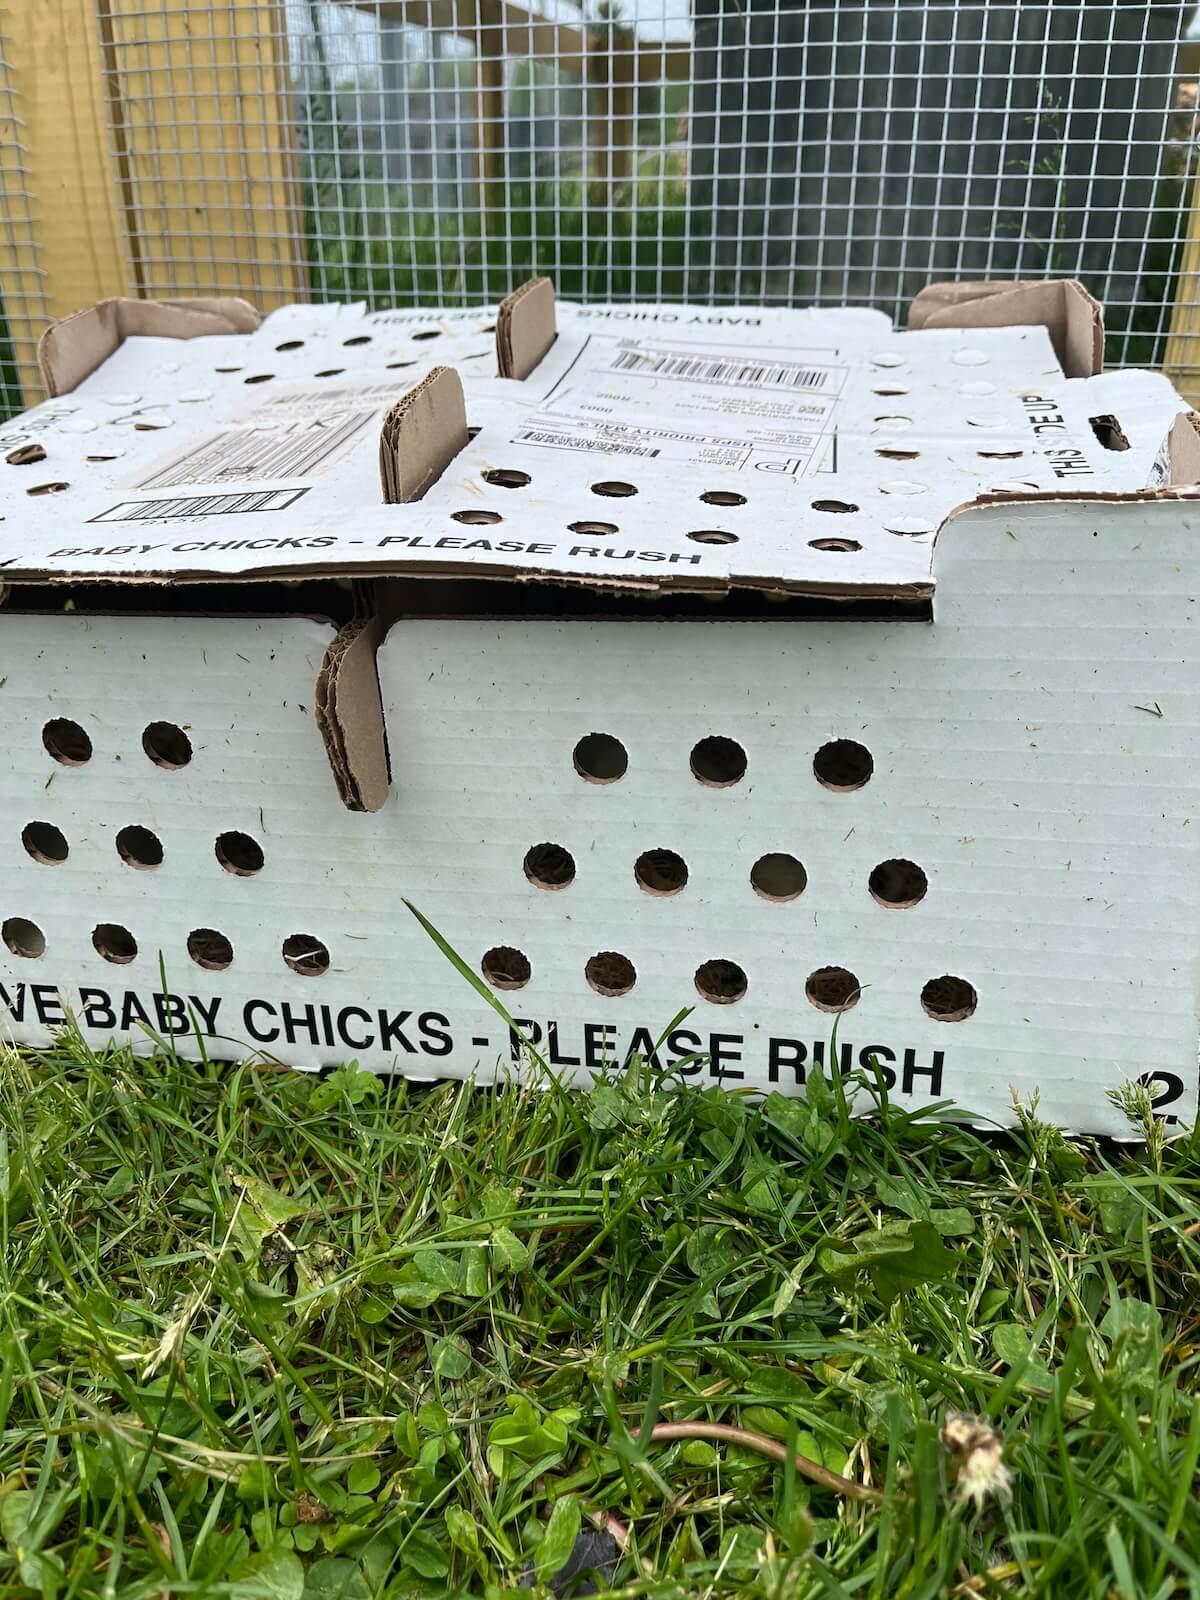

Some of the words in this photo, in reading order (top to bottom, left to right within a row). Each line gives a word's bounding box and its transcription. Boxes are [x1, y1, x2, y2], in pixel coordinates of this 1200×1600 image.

[577, 310, 679, 322] CHICKS
[688, 315, 762, 326] BABY
[1022, 395, 1059, 412] UP
[593, 422, 628, 433] MAIL
[634, 428, 705, 443] PRIORITY
[711, 436, 753, 448] USPS
[754, 458, 802, 475] P
[1044, 449, 1095, 478] THIS
[47, 543, 168, 558] BABY
[171, 536, 339, 553] CHICKS
[376, 536, 558, 555] PLEASE
[567, 545, 703, 565] RUSH
[78, 986, 222, 1038] BABY
[243, 998, 454, 1057] CHICKS
[508, 1017, 745, 1080] PLEASE
[768, 1036, 945, 1097] RUSH
